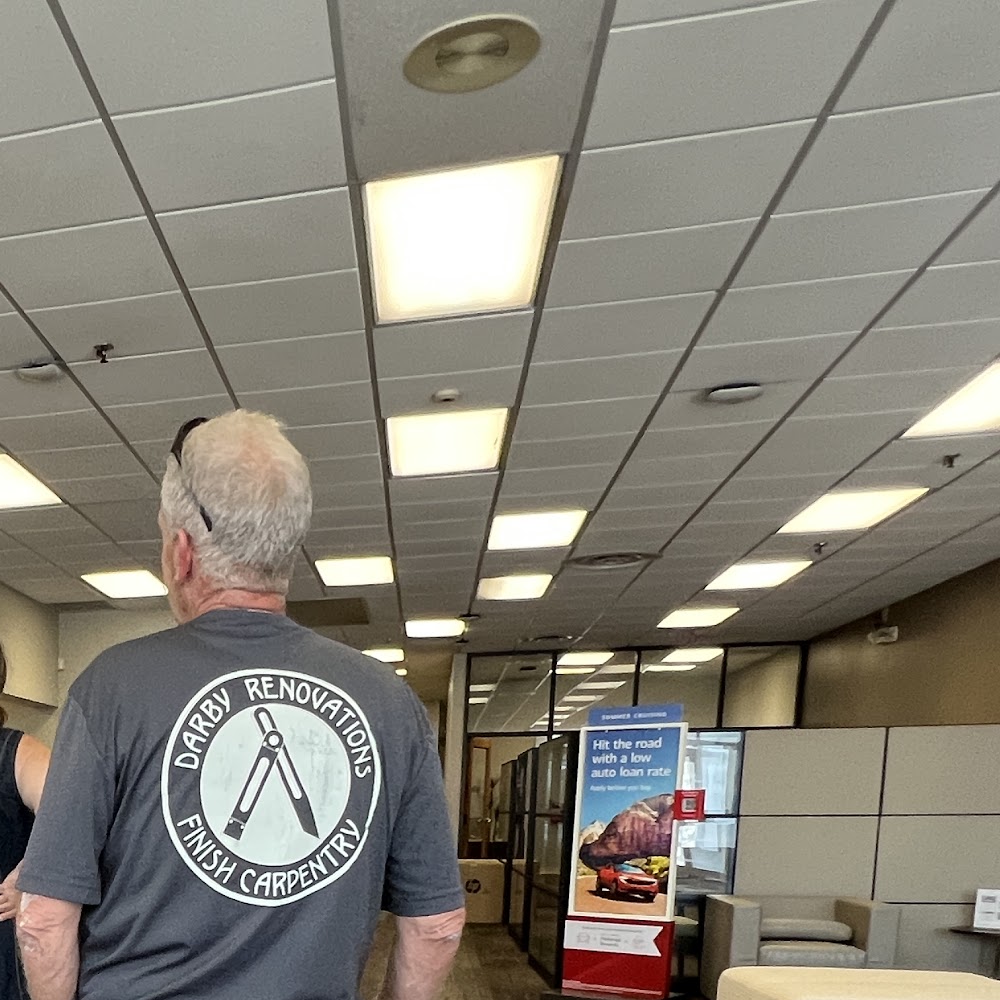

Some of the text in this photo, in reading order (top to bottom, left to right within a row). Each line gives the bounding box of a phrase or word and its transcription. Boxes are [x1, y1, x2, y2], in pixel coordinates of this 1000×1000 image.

[174, 676, 372, 778] DARBY RENOVATIONS
[592, 737, 663, 750] Hit the road
[591, 752, 652, 764] with a low
[590, 766, 672, 778] auto loan rate
[176, 813, 361, 897] FINISH CARPENTRY
